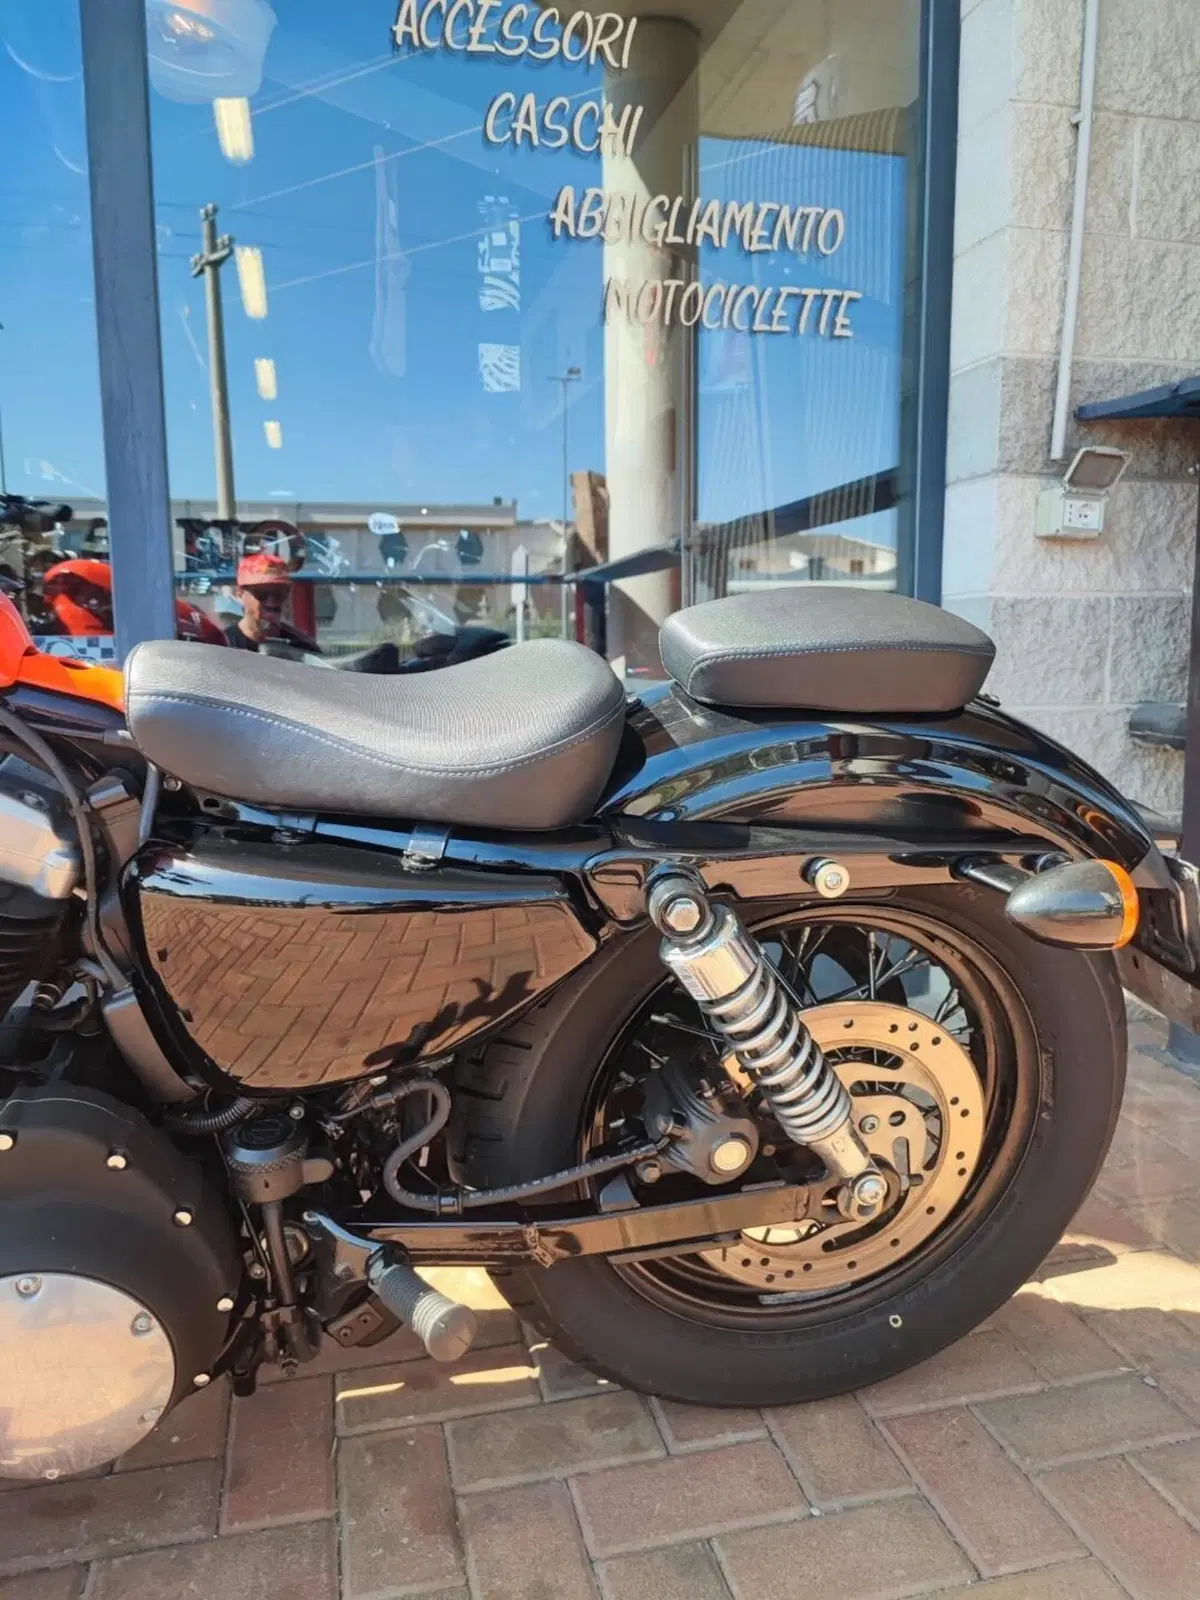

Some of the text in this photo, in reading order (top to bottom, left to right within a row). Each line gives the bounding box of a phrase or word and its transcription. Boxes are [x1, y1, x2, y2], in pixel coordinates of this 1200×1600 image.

[392, 0, 637, 69] ACCESSORI
[484, 92, 643, 158] CASCHI
[550, 185, 844, 257] ABBIGLIAMENTO
[604, 276, 861, 338] MOTOCICLETTE
